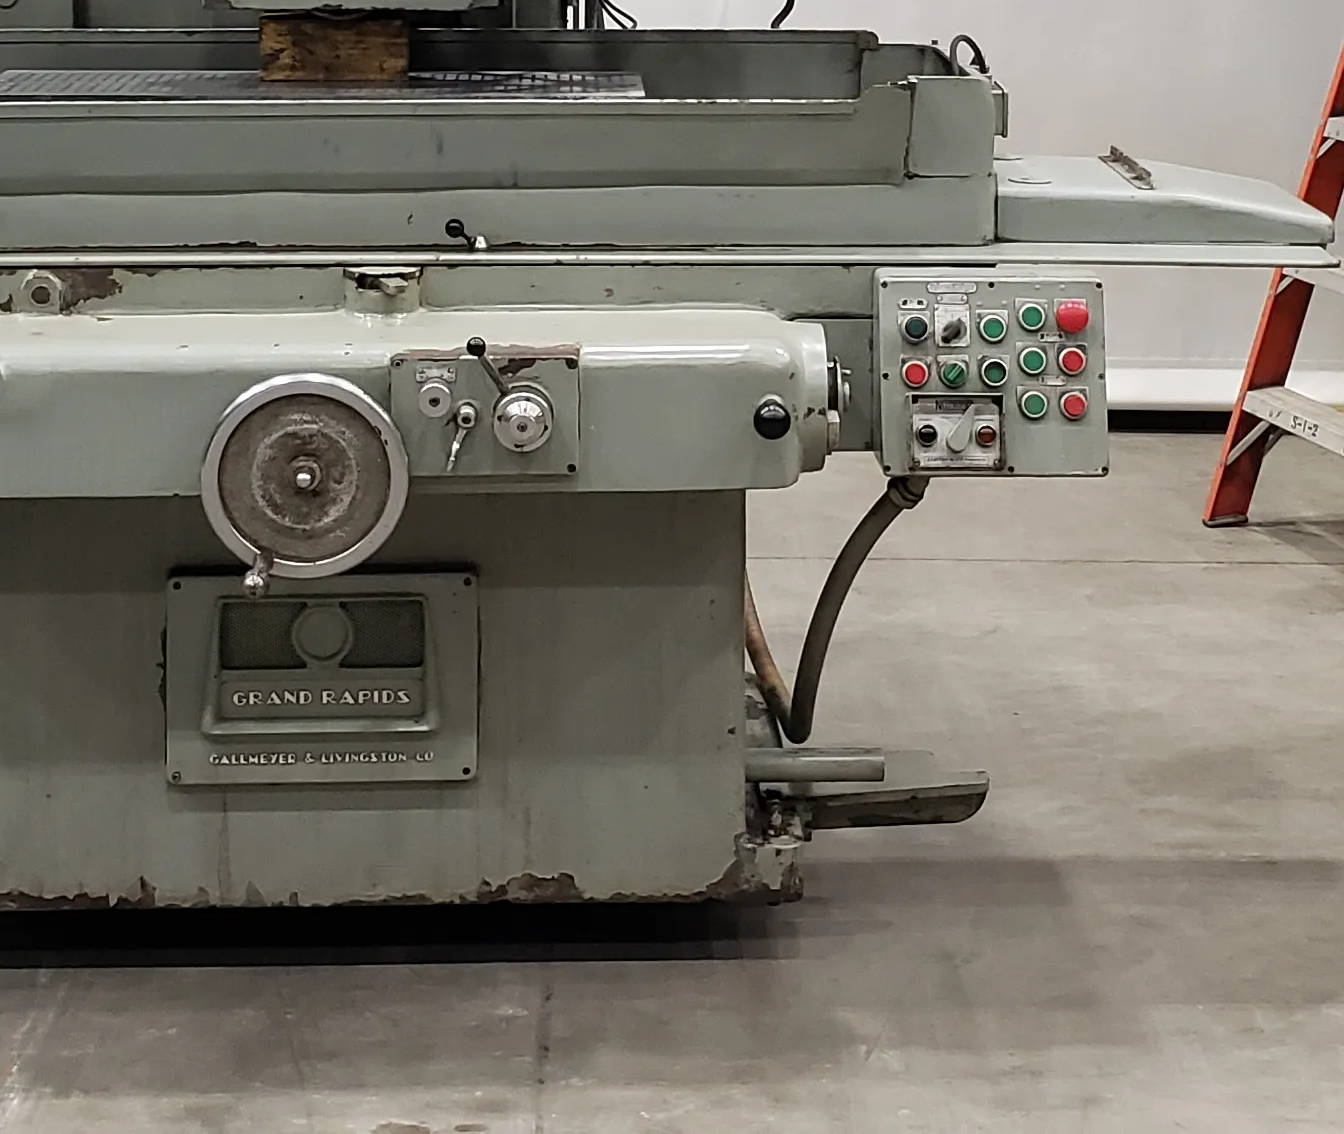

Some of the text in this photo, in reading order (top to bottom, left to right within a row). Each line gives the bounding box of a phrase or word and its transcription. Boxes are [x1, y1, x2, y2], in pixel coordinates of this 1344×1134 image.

[1291, 415, 1319, 437] S-1-2
[232, 689, 411, 705] GRAND RAPIDS
[209, 753, 296, 765] GALLMEYER
[305, 752, 315, 764] &
[321, 752, 407, 763] LIVINGSTON
